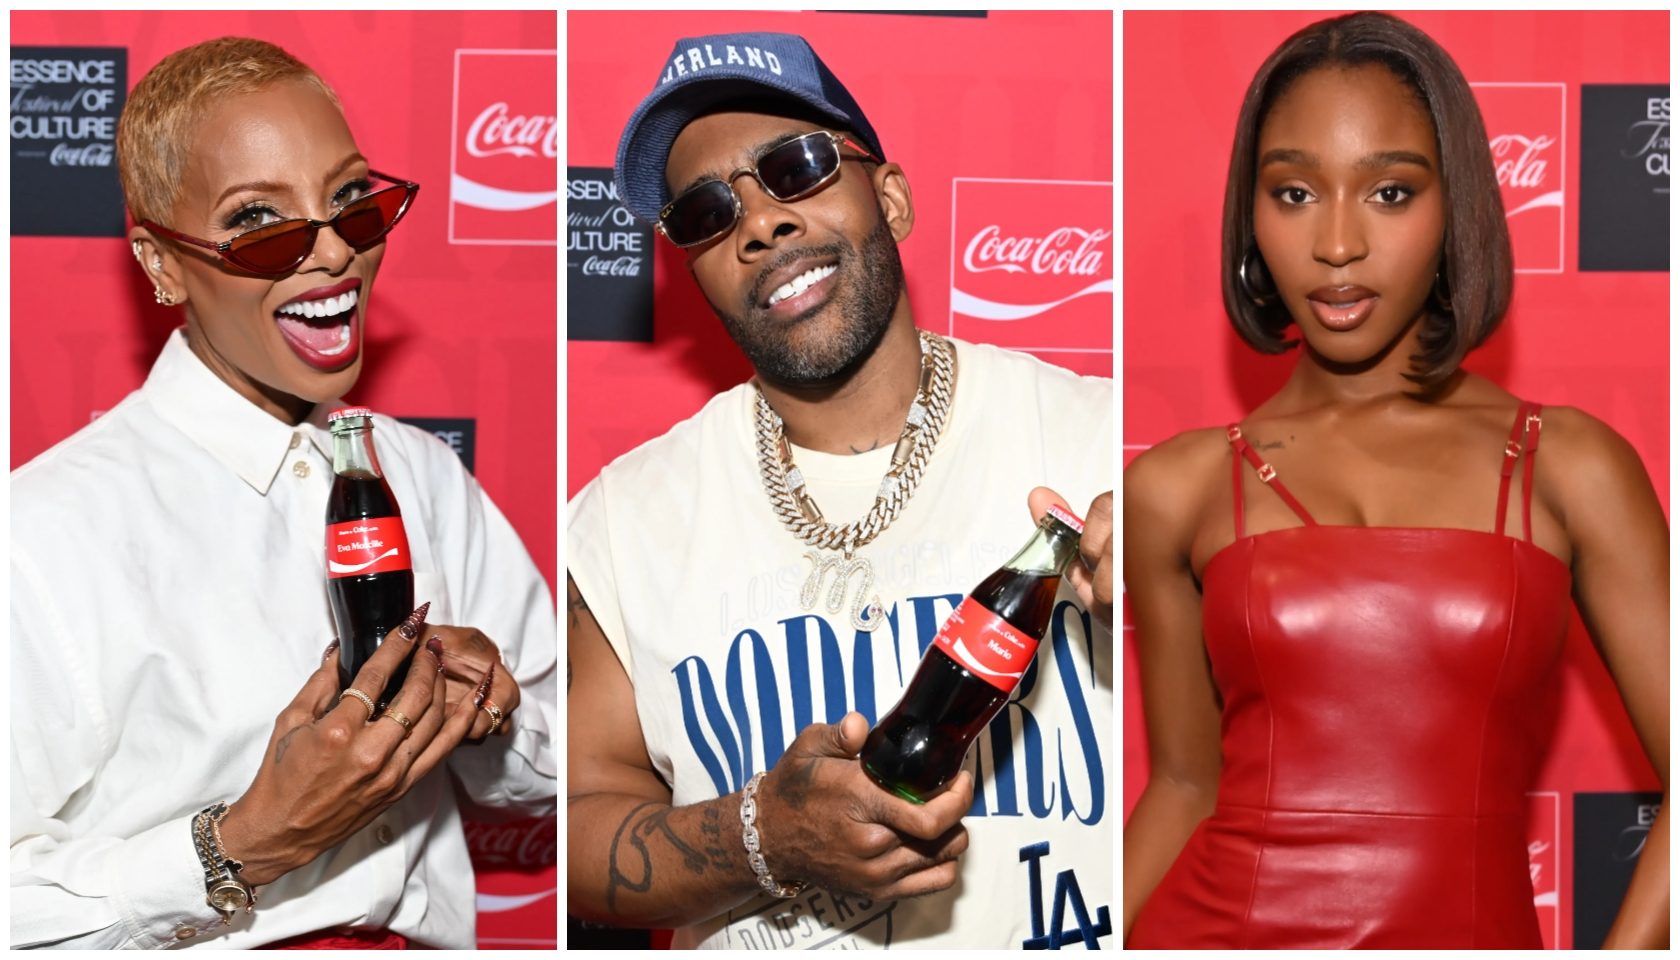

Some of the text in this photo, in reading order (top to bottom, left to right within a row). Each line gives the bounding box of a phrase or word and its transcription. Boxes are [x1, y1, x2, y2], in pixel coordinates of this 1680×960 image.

[10, 59, 115, 83] ESSENCE
[82, 88, 115, 111] OF
[10, 116, 115, 139] CULTURE
[963, 224, 1112, 276] Coca-Cola
[337, 544, 352, 553] Eva
[987, 639, 1013, 660] Mario
